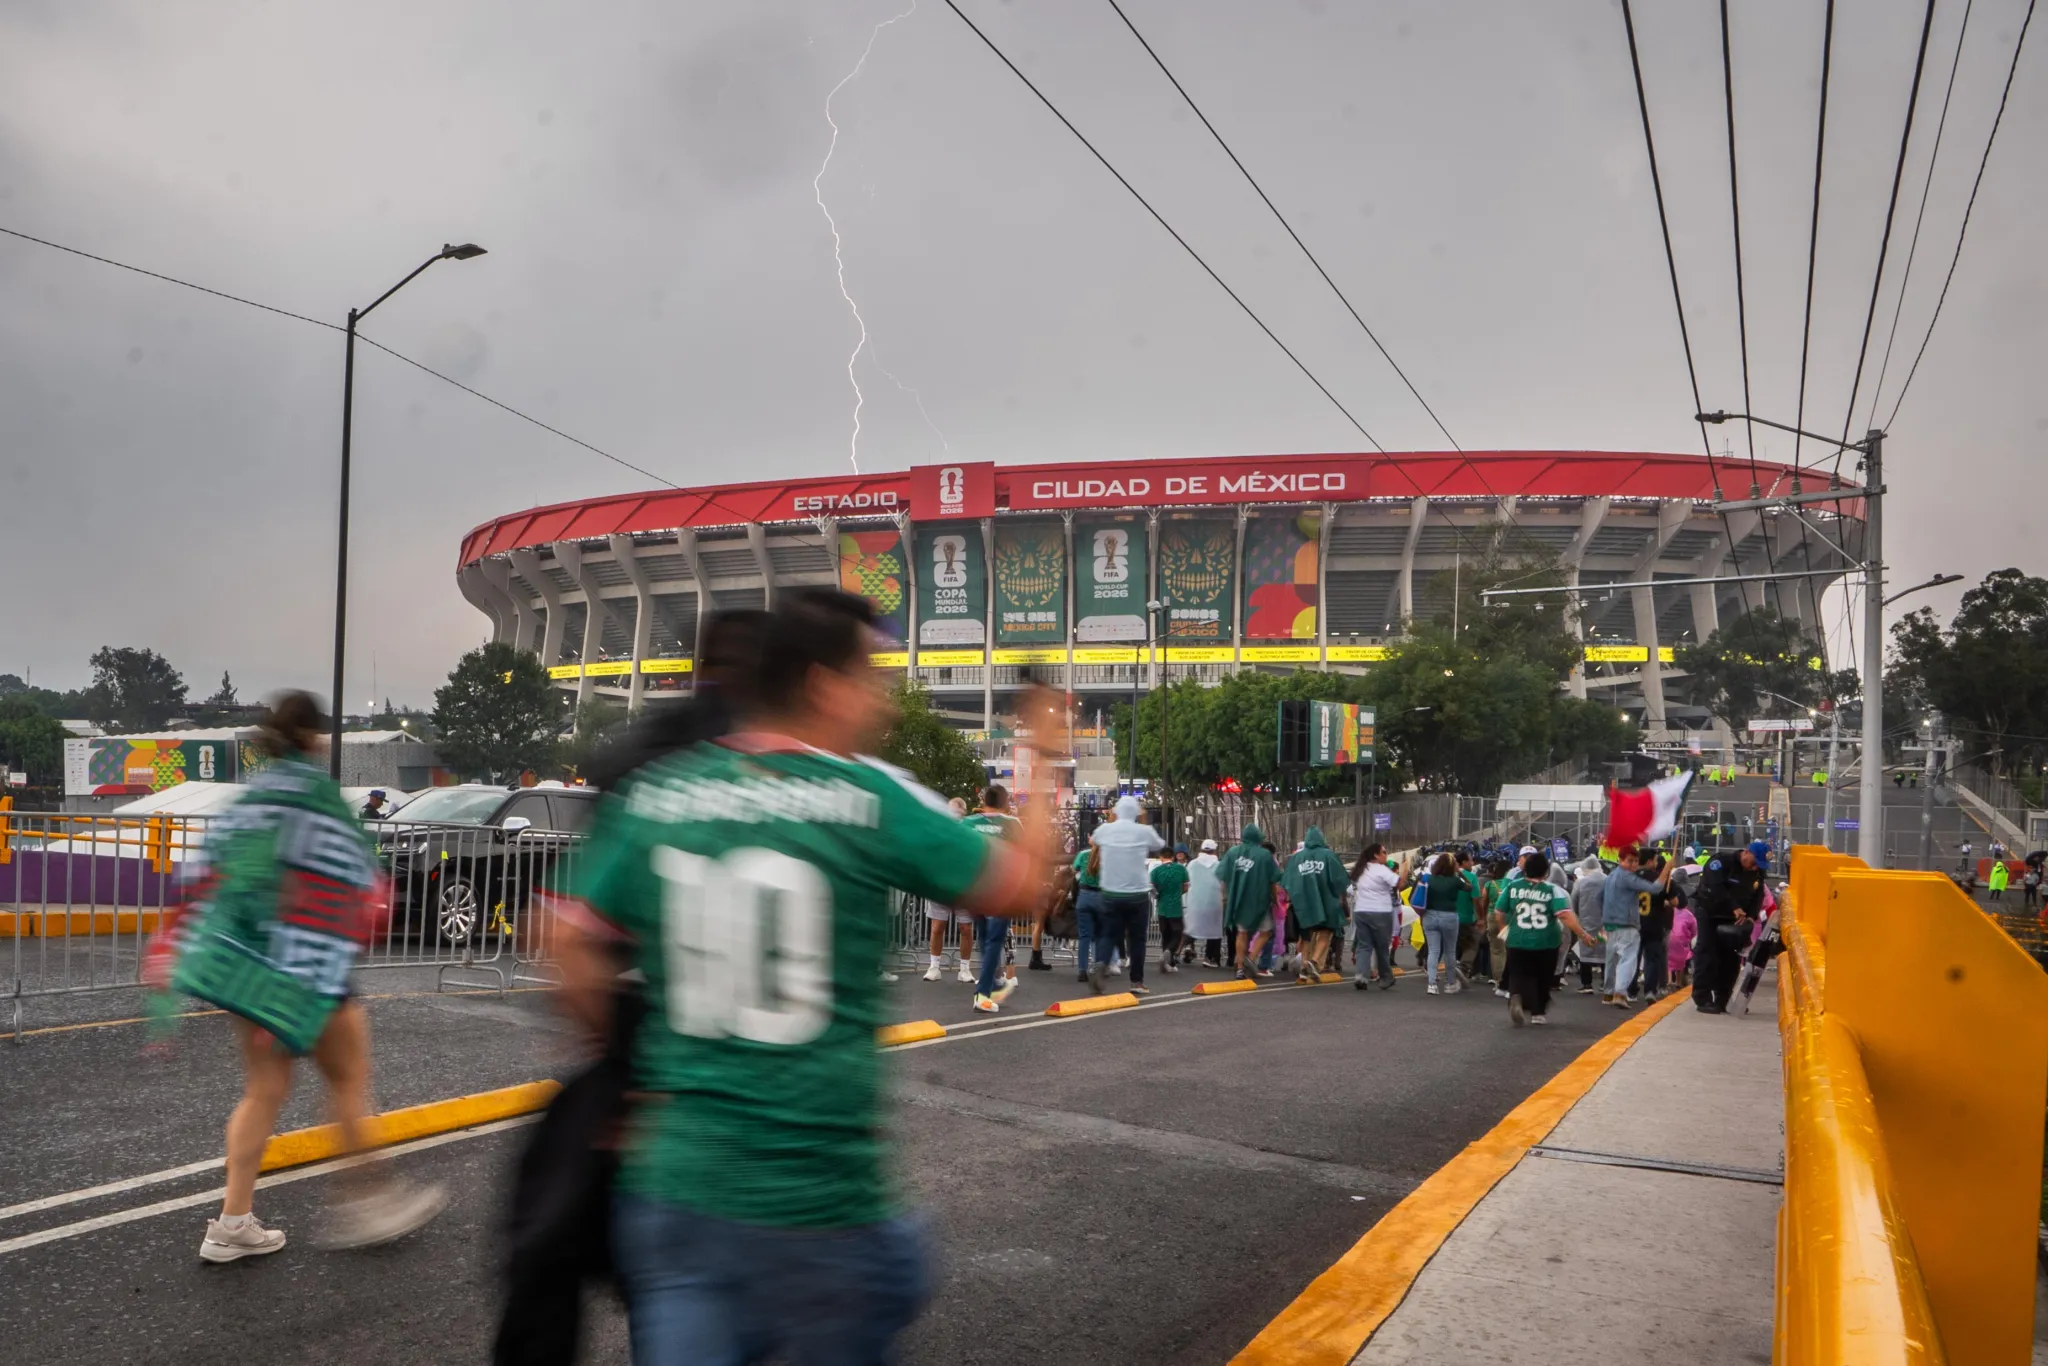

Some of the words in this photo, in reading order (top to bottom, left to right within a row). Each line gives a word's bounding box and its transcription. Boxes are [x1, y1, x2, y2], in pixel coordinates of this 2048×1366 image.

[1032, 478, 1150, 499] CIUDAD
[1165, 476, 1208, 495] DE
[1219, 471, 1346, 494] MÉXICO
[794, 491, 897, 512] ESTADIO
[935, 588, 967, 599] COPA
[1094, 589, 1128, 598] 2026
[935, 598, 968, 606] MUNDIAL
[935, 605, 968, 614] 2026
[1171, 609, 1219, 619] SOMOS
[1003, 611, 1025, 623] WE
[1027, 611, 1056, 622] ARE
[1037, 622, 1056, 631] CITY
[1516, 902, 1548, 930] 26
[652, 844, 836, 1045] 10
